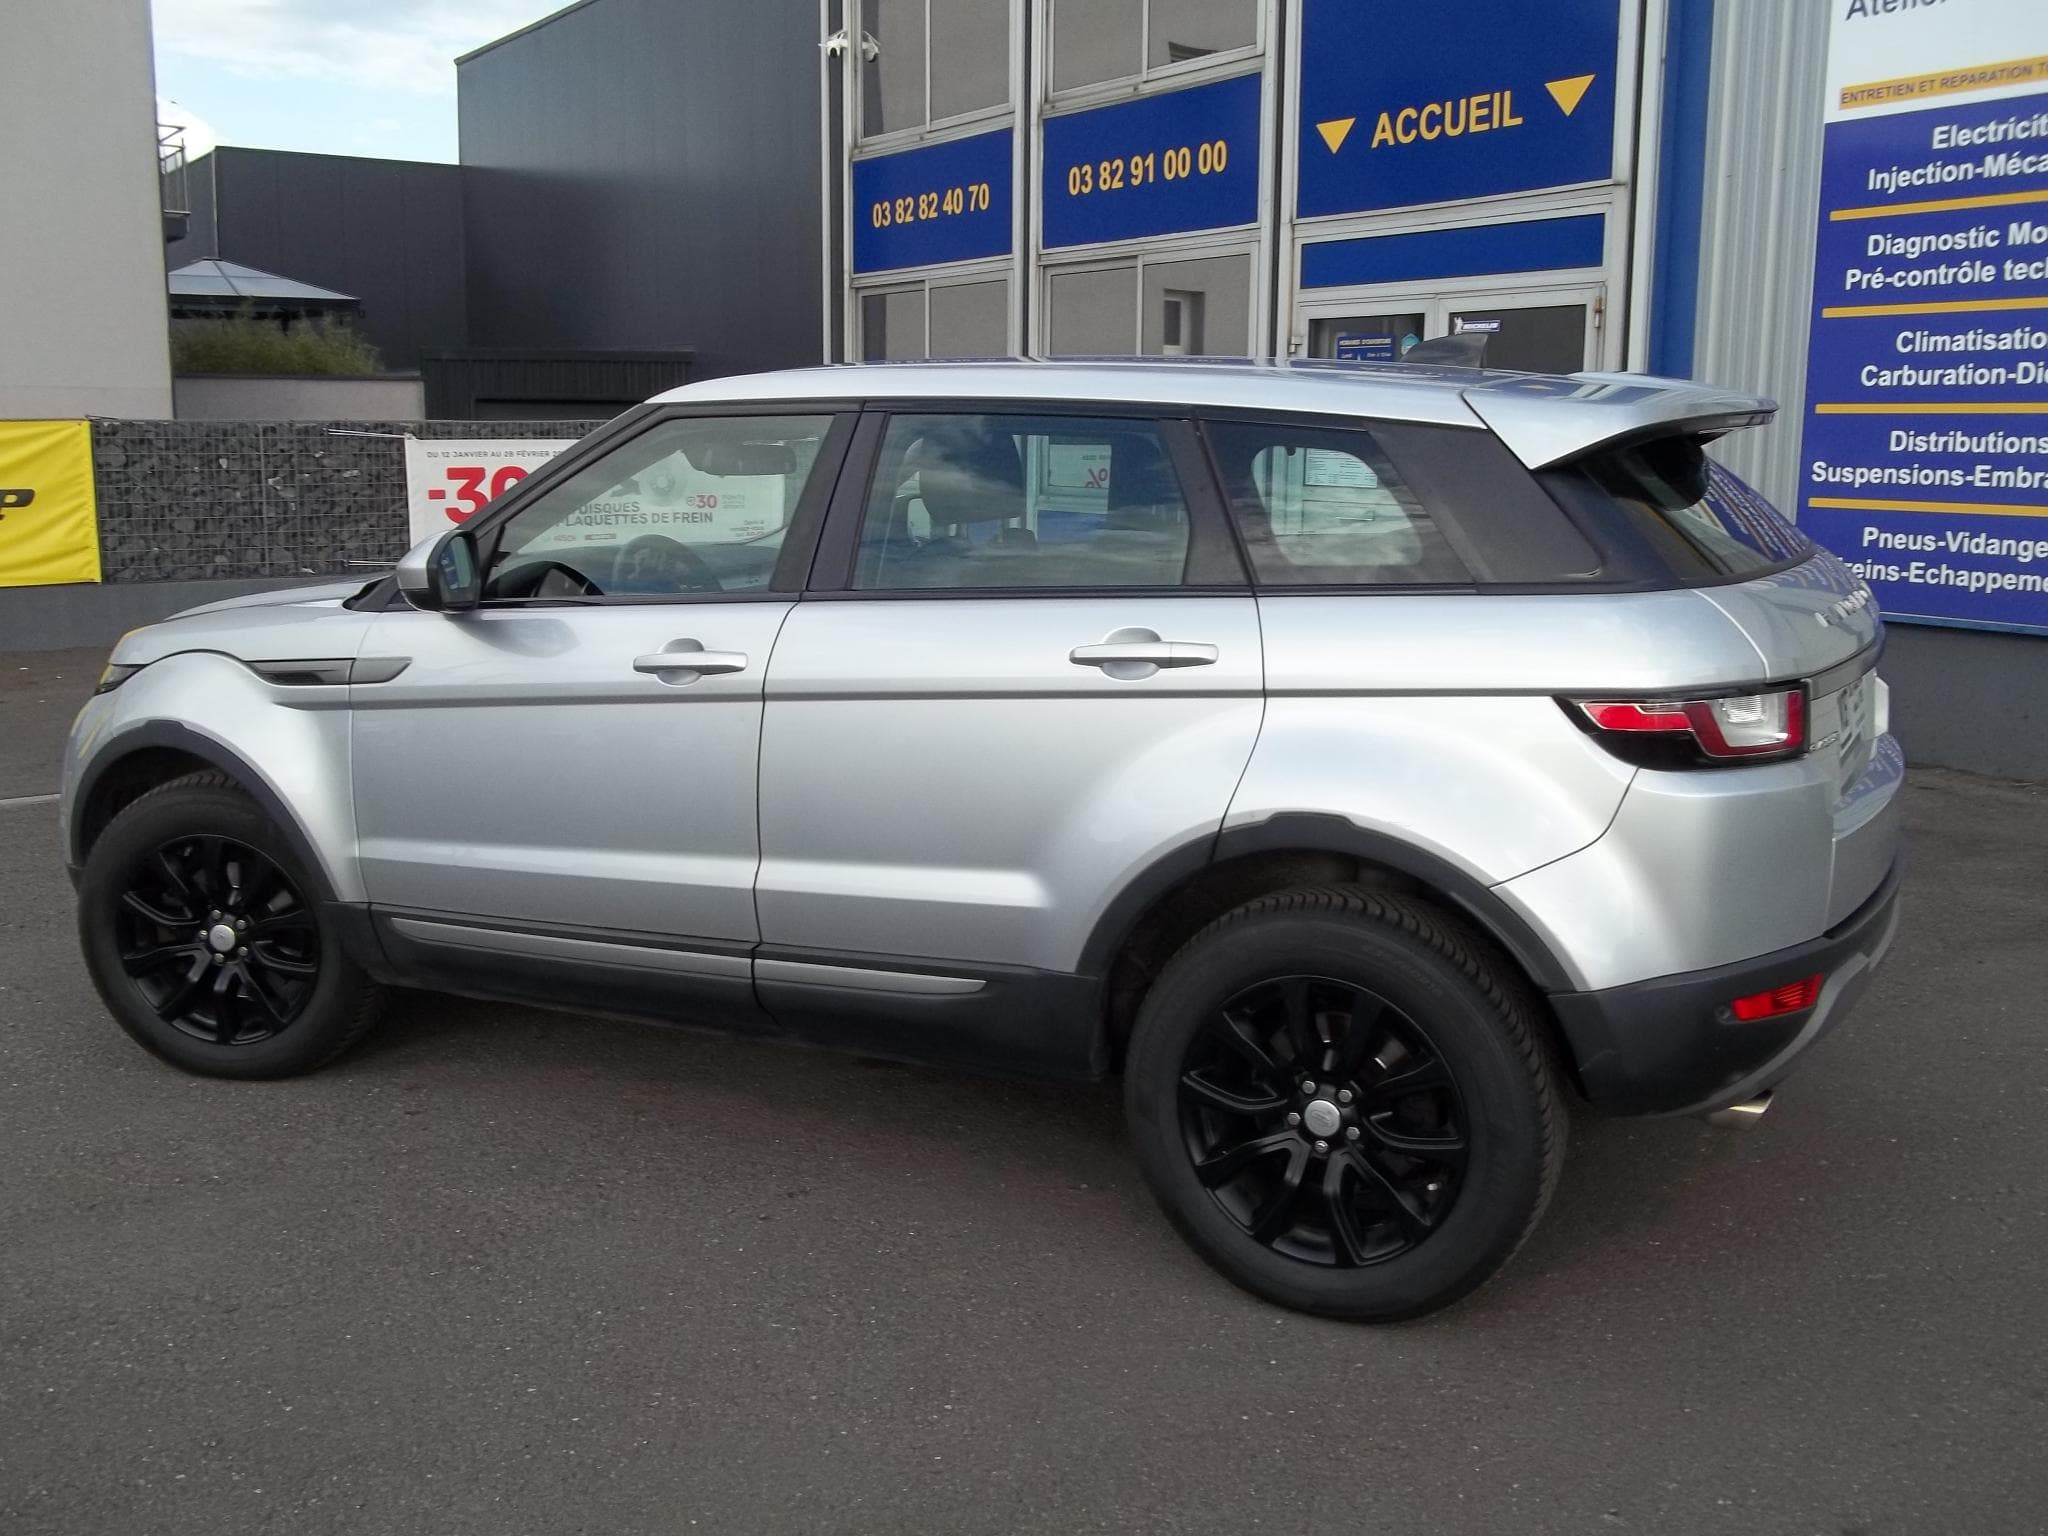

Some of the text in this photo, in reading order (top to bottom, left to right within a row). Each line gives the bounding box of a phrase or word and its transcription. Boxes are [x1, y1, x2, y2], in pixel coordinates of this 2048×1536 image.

[1841, 82, 1915, 104] ENTRETIEN
[1919, 79, 1936, 93] ET
[1940, 64, 2033, 88] REPARATION
[1371, 90, 1523, 148] ACCUEIL
[1931, 113, 2048, 150] Electricit
[1068, 140, 1227, 196] 03 82 91 00 00
[873, 183, 989, 228] 03 82 82 40 70
[1867, 226, 2000, 259] Diagnostic
[1845, 260, 1996, 291] Pré-contrôle
[1895, 326, 2048, 353] Climatisatio
[1889, 430, 2048, 454] Distributions
[556, 511, 713, 527] LAQUETTES DE FREIN
[1862, 527, 2048, 563] Pneus-Vidange
